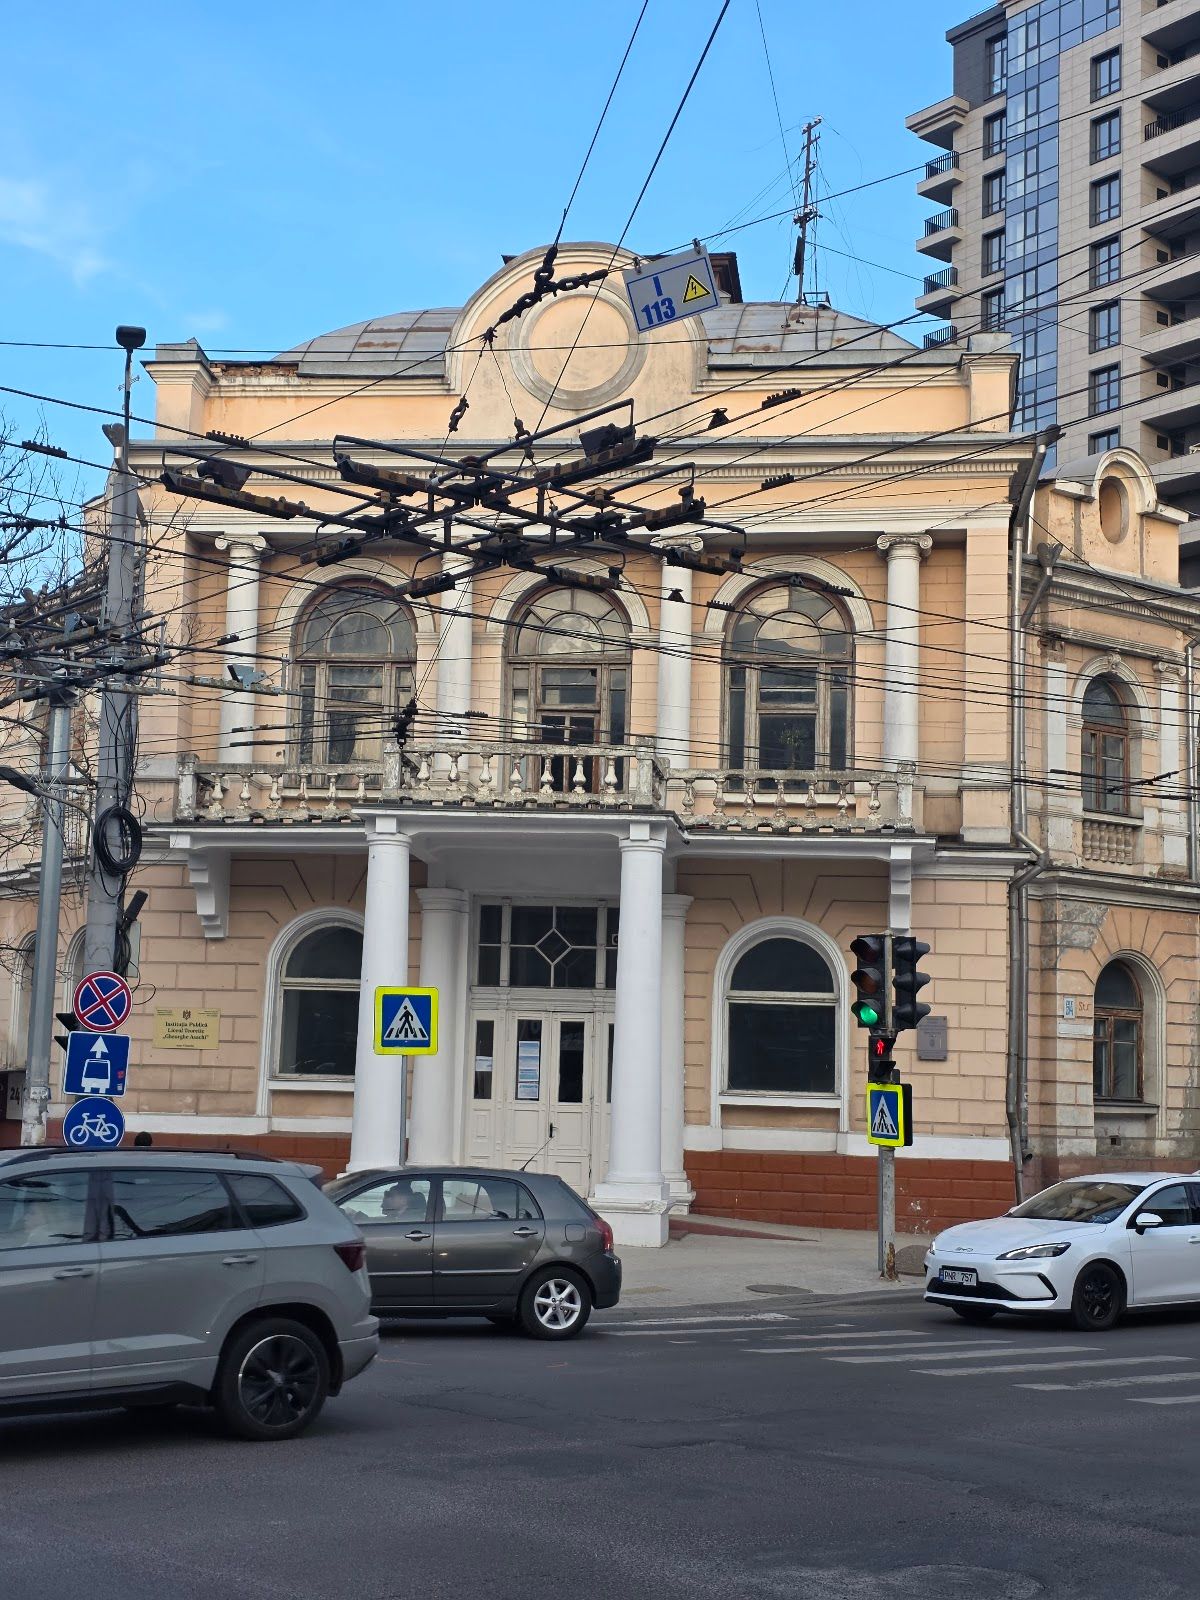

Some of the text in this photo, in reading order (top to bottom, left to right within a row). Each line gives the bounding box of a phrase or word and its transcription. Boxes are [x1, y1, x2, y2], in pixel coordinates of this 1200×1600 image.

[641, 297, 676, 326] 113
[944, 1270, 973, 1282] PNR 757
